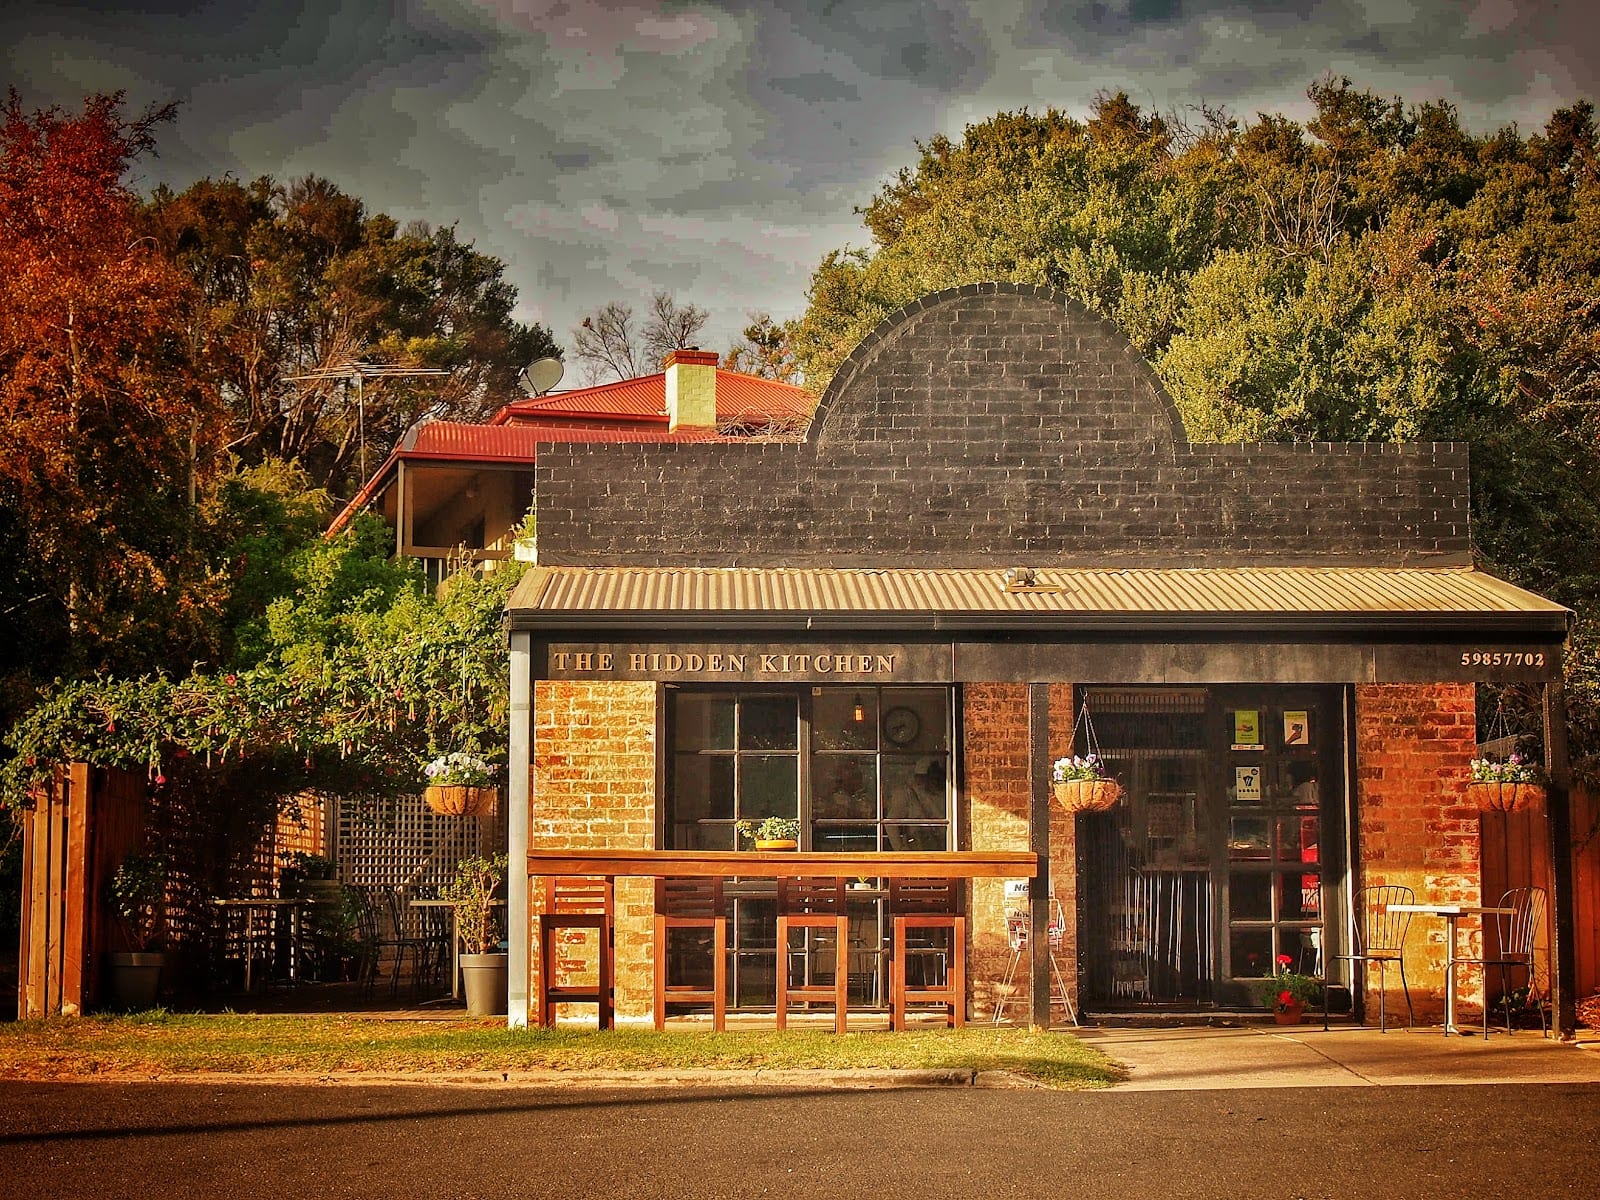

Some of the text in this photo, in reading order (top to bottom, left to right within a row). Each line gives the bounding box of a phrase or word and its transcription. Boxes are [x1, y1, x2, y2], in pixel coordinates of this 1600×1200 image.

[554, 653, 896, 673] THE HIDDEN KITCHEN
[1461, 652, 1544, 666] 59857702
